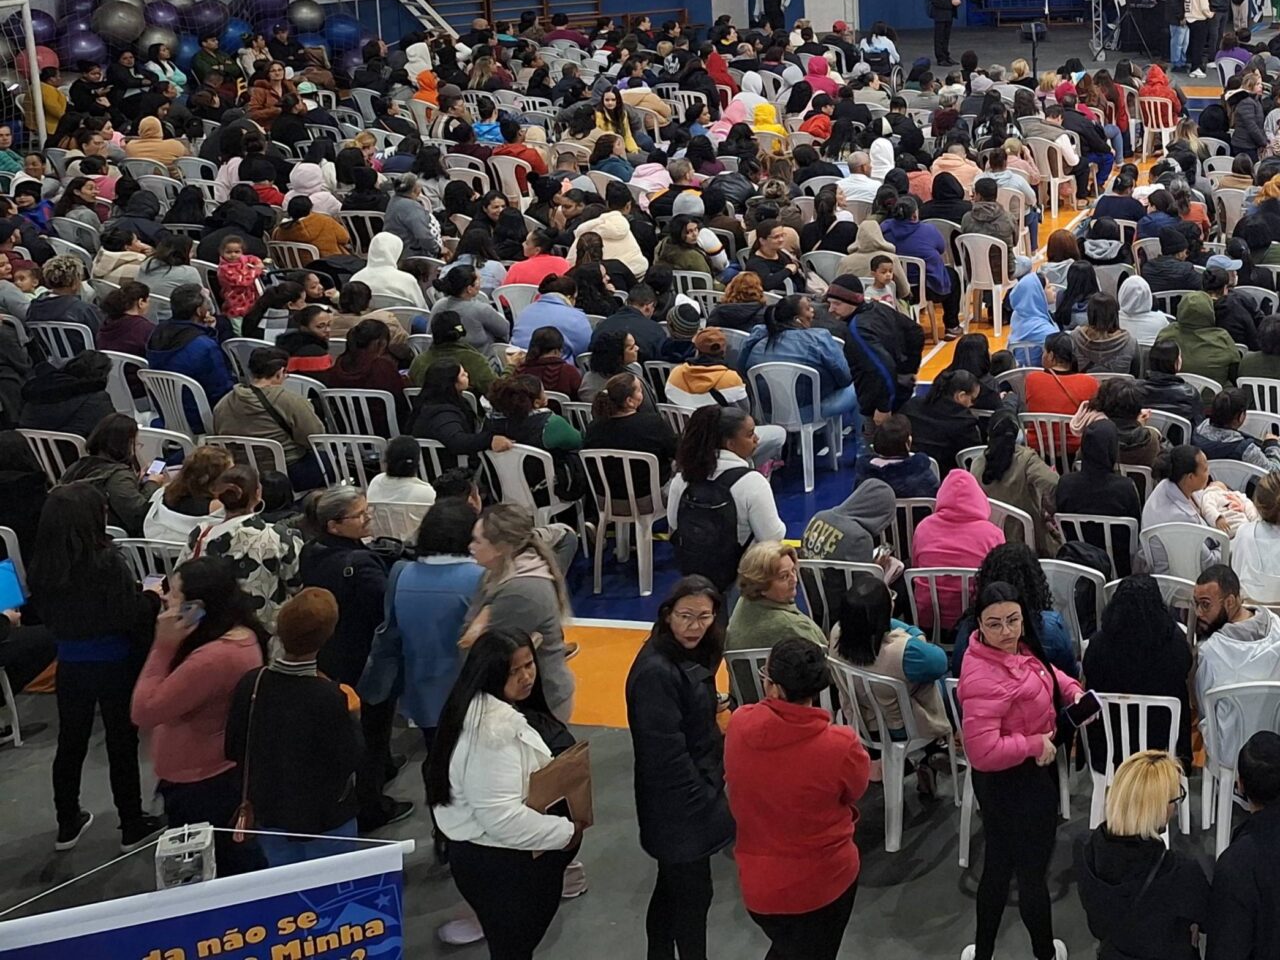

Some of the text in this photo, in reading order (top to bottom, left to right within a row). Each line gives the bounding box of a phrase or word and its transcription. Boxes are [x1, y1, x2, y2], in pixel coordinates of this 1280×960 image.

[197, 924, 267, 958] não
[277, 910, 319, 936] se
[270, 917, 385, 960] Minha
